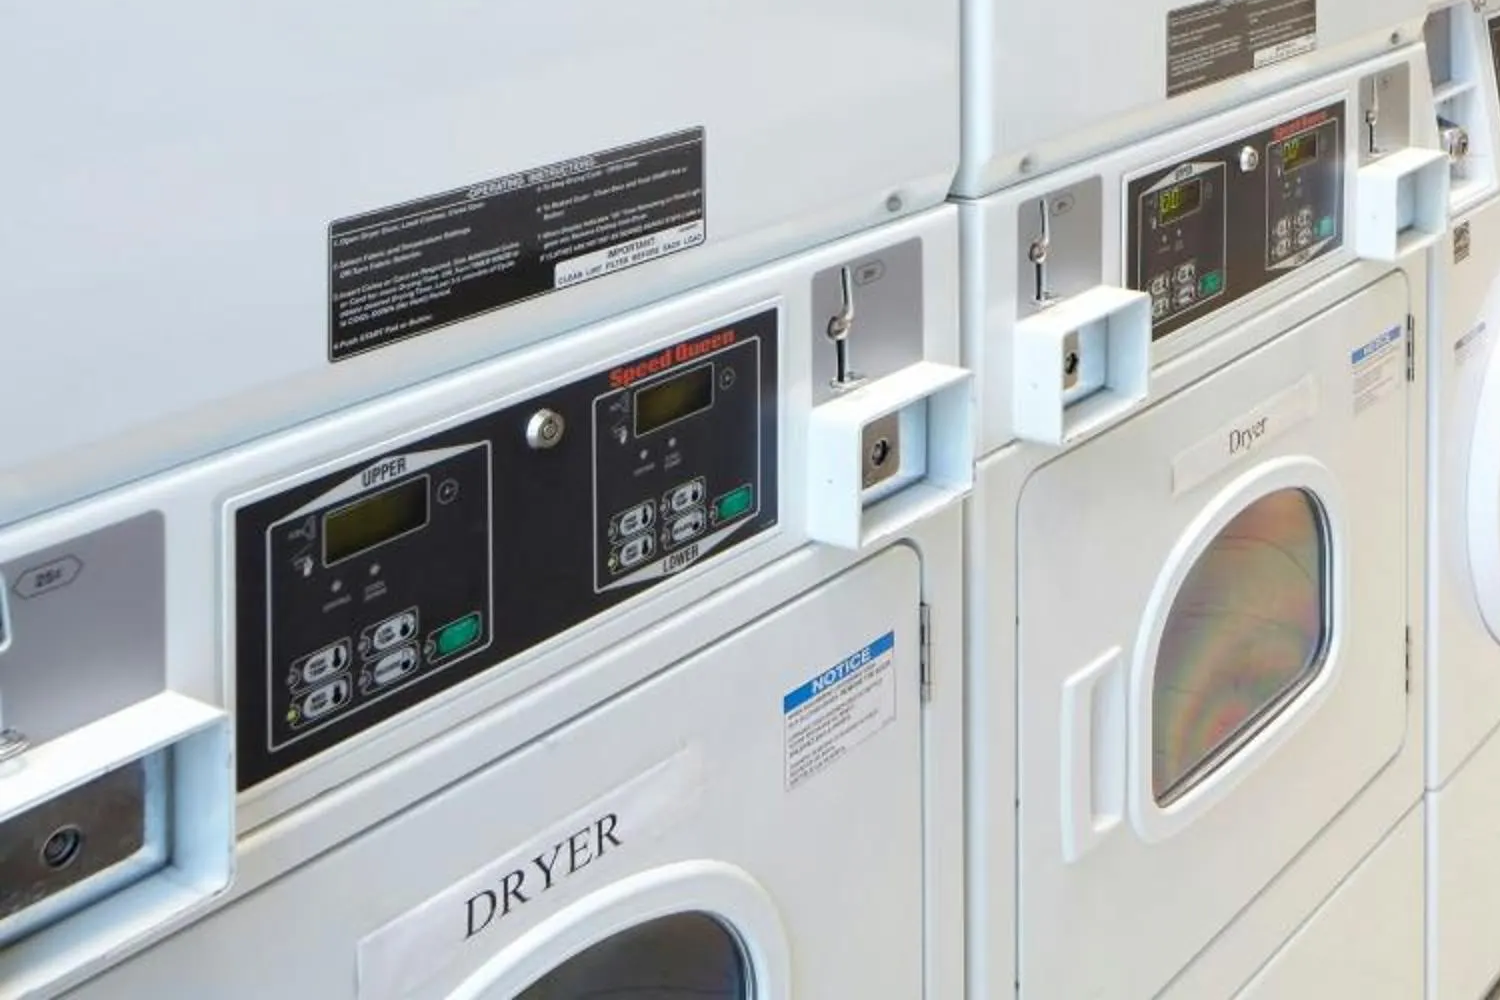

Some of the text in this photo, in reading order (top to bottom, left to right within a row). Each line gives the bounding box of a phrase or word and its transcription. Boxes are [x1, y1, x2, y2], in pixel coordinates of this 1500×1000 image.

[608, 329, 737, 389] Speed Queen
[1228, 416, 1270, 455] Dryer
[361, 457, 408, 488] UPPER
[661, 544, 700, 574] LOWER
[811, 646, 873, 694] NOTICE
[464, 812, 624, 940] DRYER
